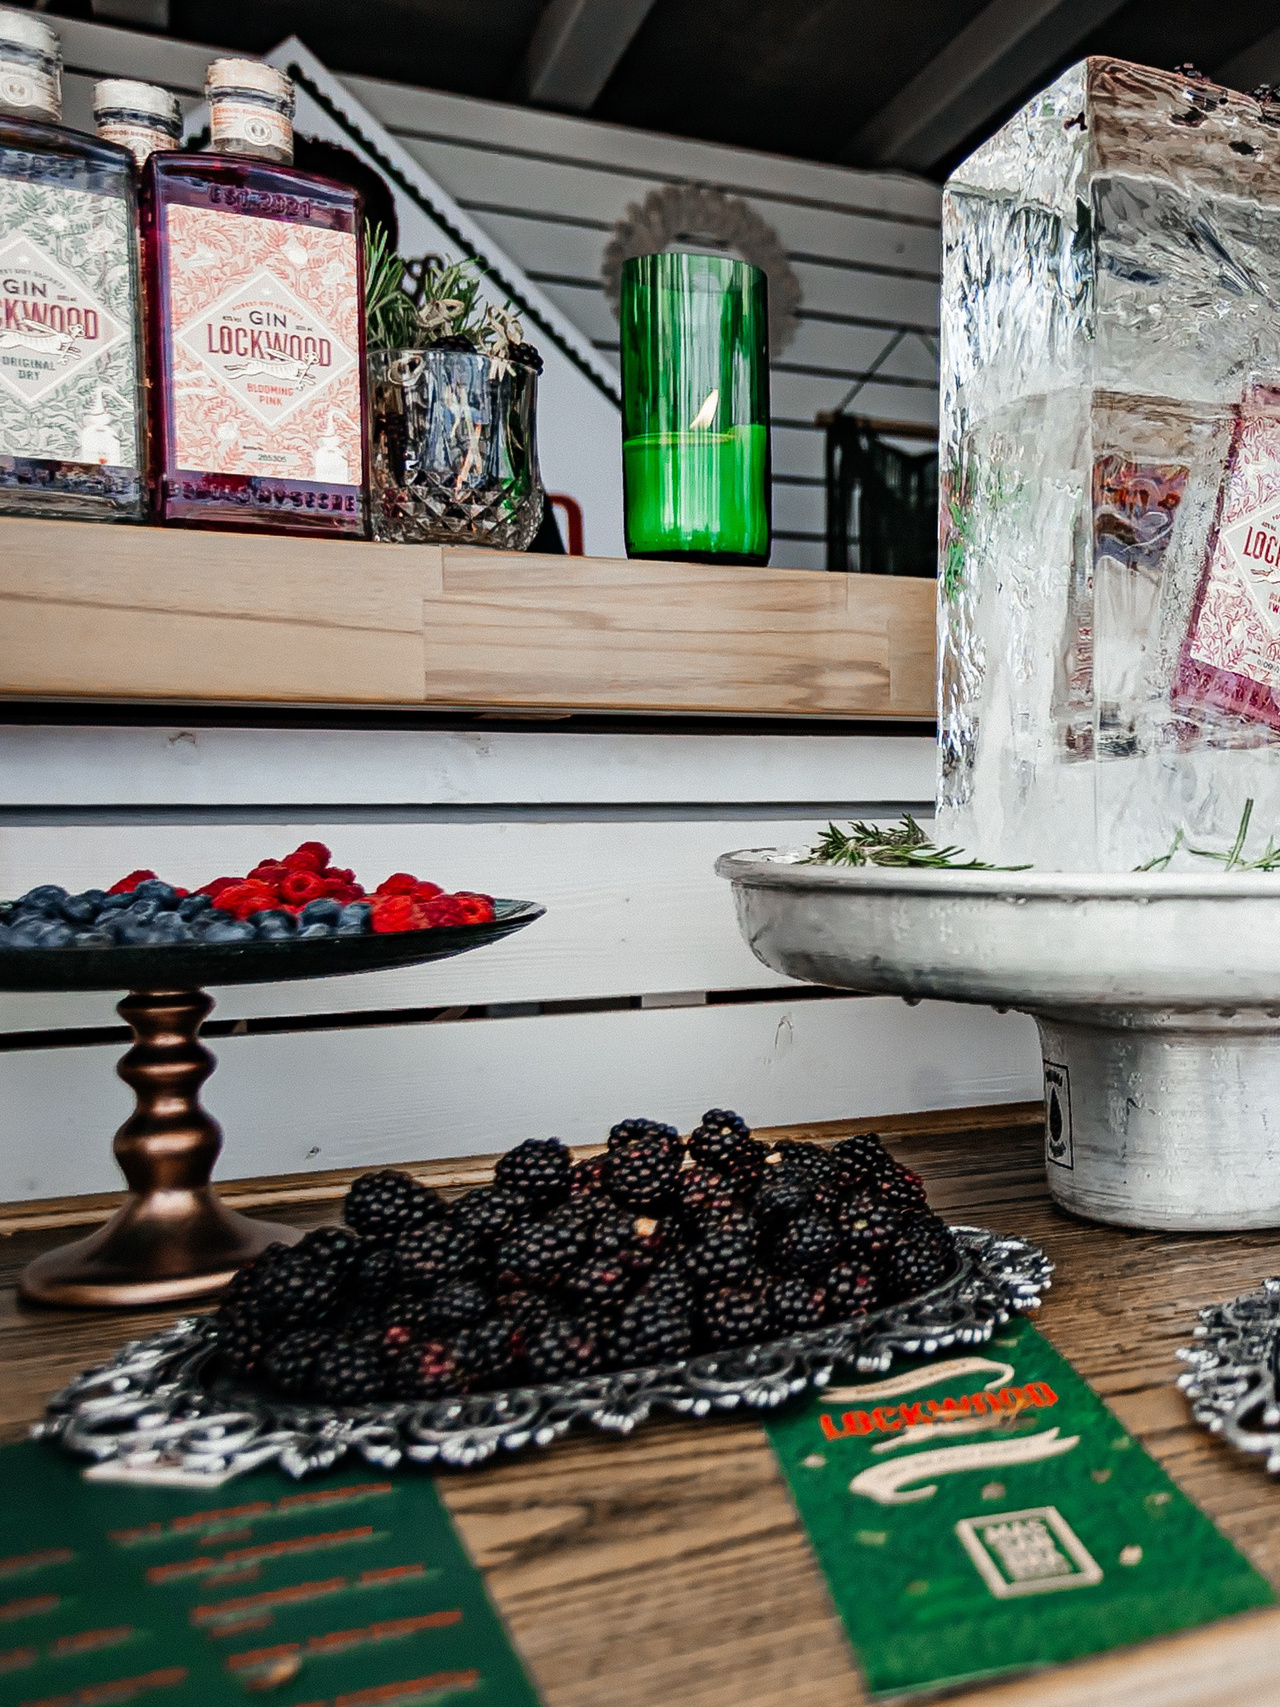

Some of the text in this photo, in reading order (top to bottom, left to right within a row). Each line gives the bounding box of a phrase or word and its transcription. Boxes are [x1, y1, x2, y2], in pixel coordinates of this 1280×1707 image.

[3, 278, 46, 298] GIN
[0, 297, 98, 340] KWOOD
[248, 310, 286, 329] GIN
[207, 323, 332, 367] LOCKWOOD
[2, 356, 55, 371] ORIGINAL
[18, 369, 40, 381] DRY
[246, 382, 295, 397] BLOOMING
[259, 394, 283, 406] PINK
[819, 1382, 1059, 1442] LOCKWOOD
